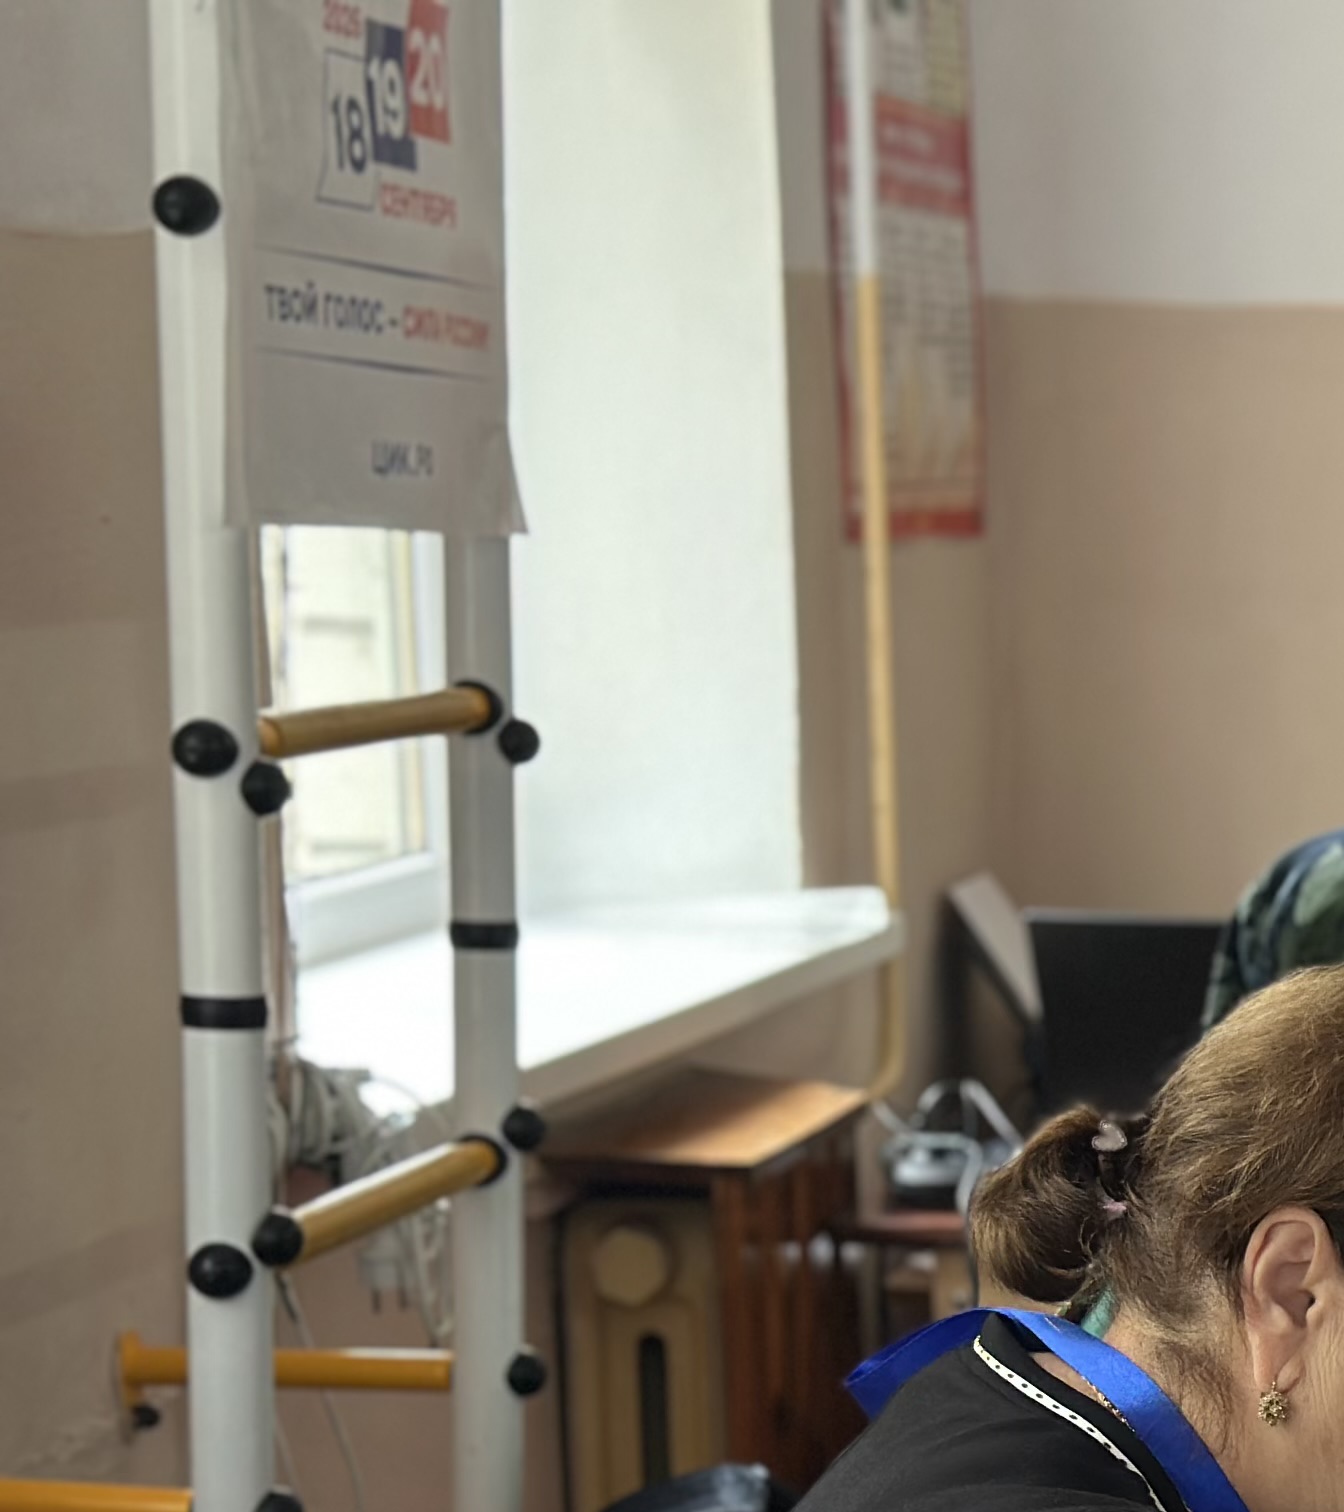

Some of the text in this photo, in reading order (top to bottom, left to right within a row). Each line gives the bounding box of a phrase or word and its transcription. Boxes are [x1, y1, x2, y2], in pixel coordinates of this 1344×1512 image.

[368, 56, 408, 140] 19
[409, 27, 447, 111] 20
[331, 93, 367, 174] 18
[264, 281, 318, 326] ТВОЙ
[323, 292, 384, 336] ГОЛОС
